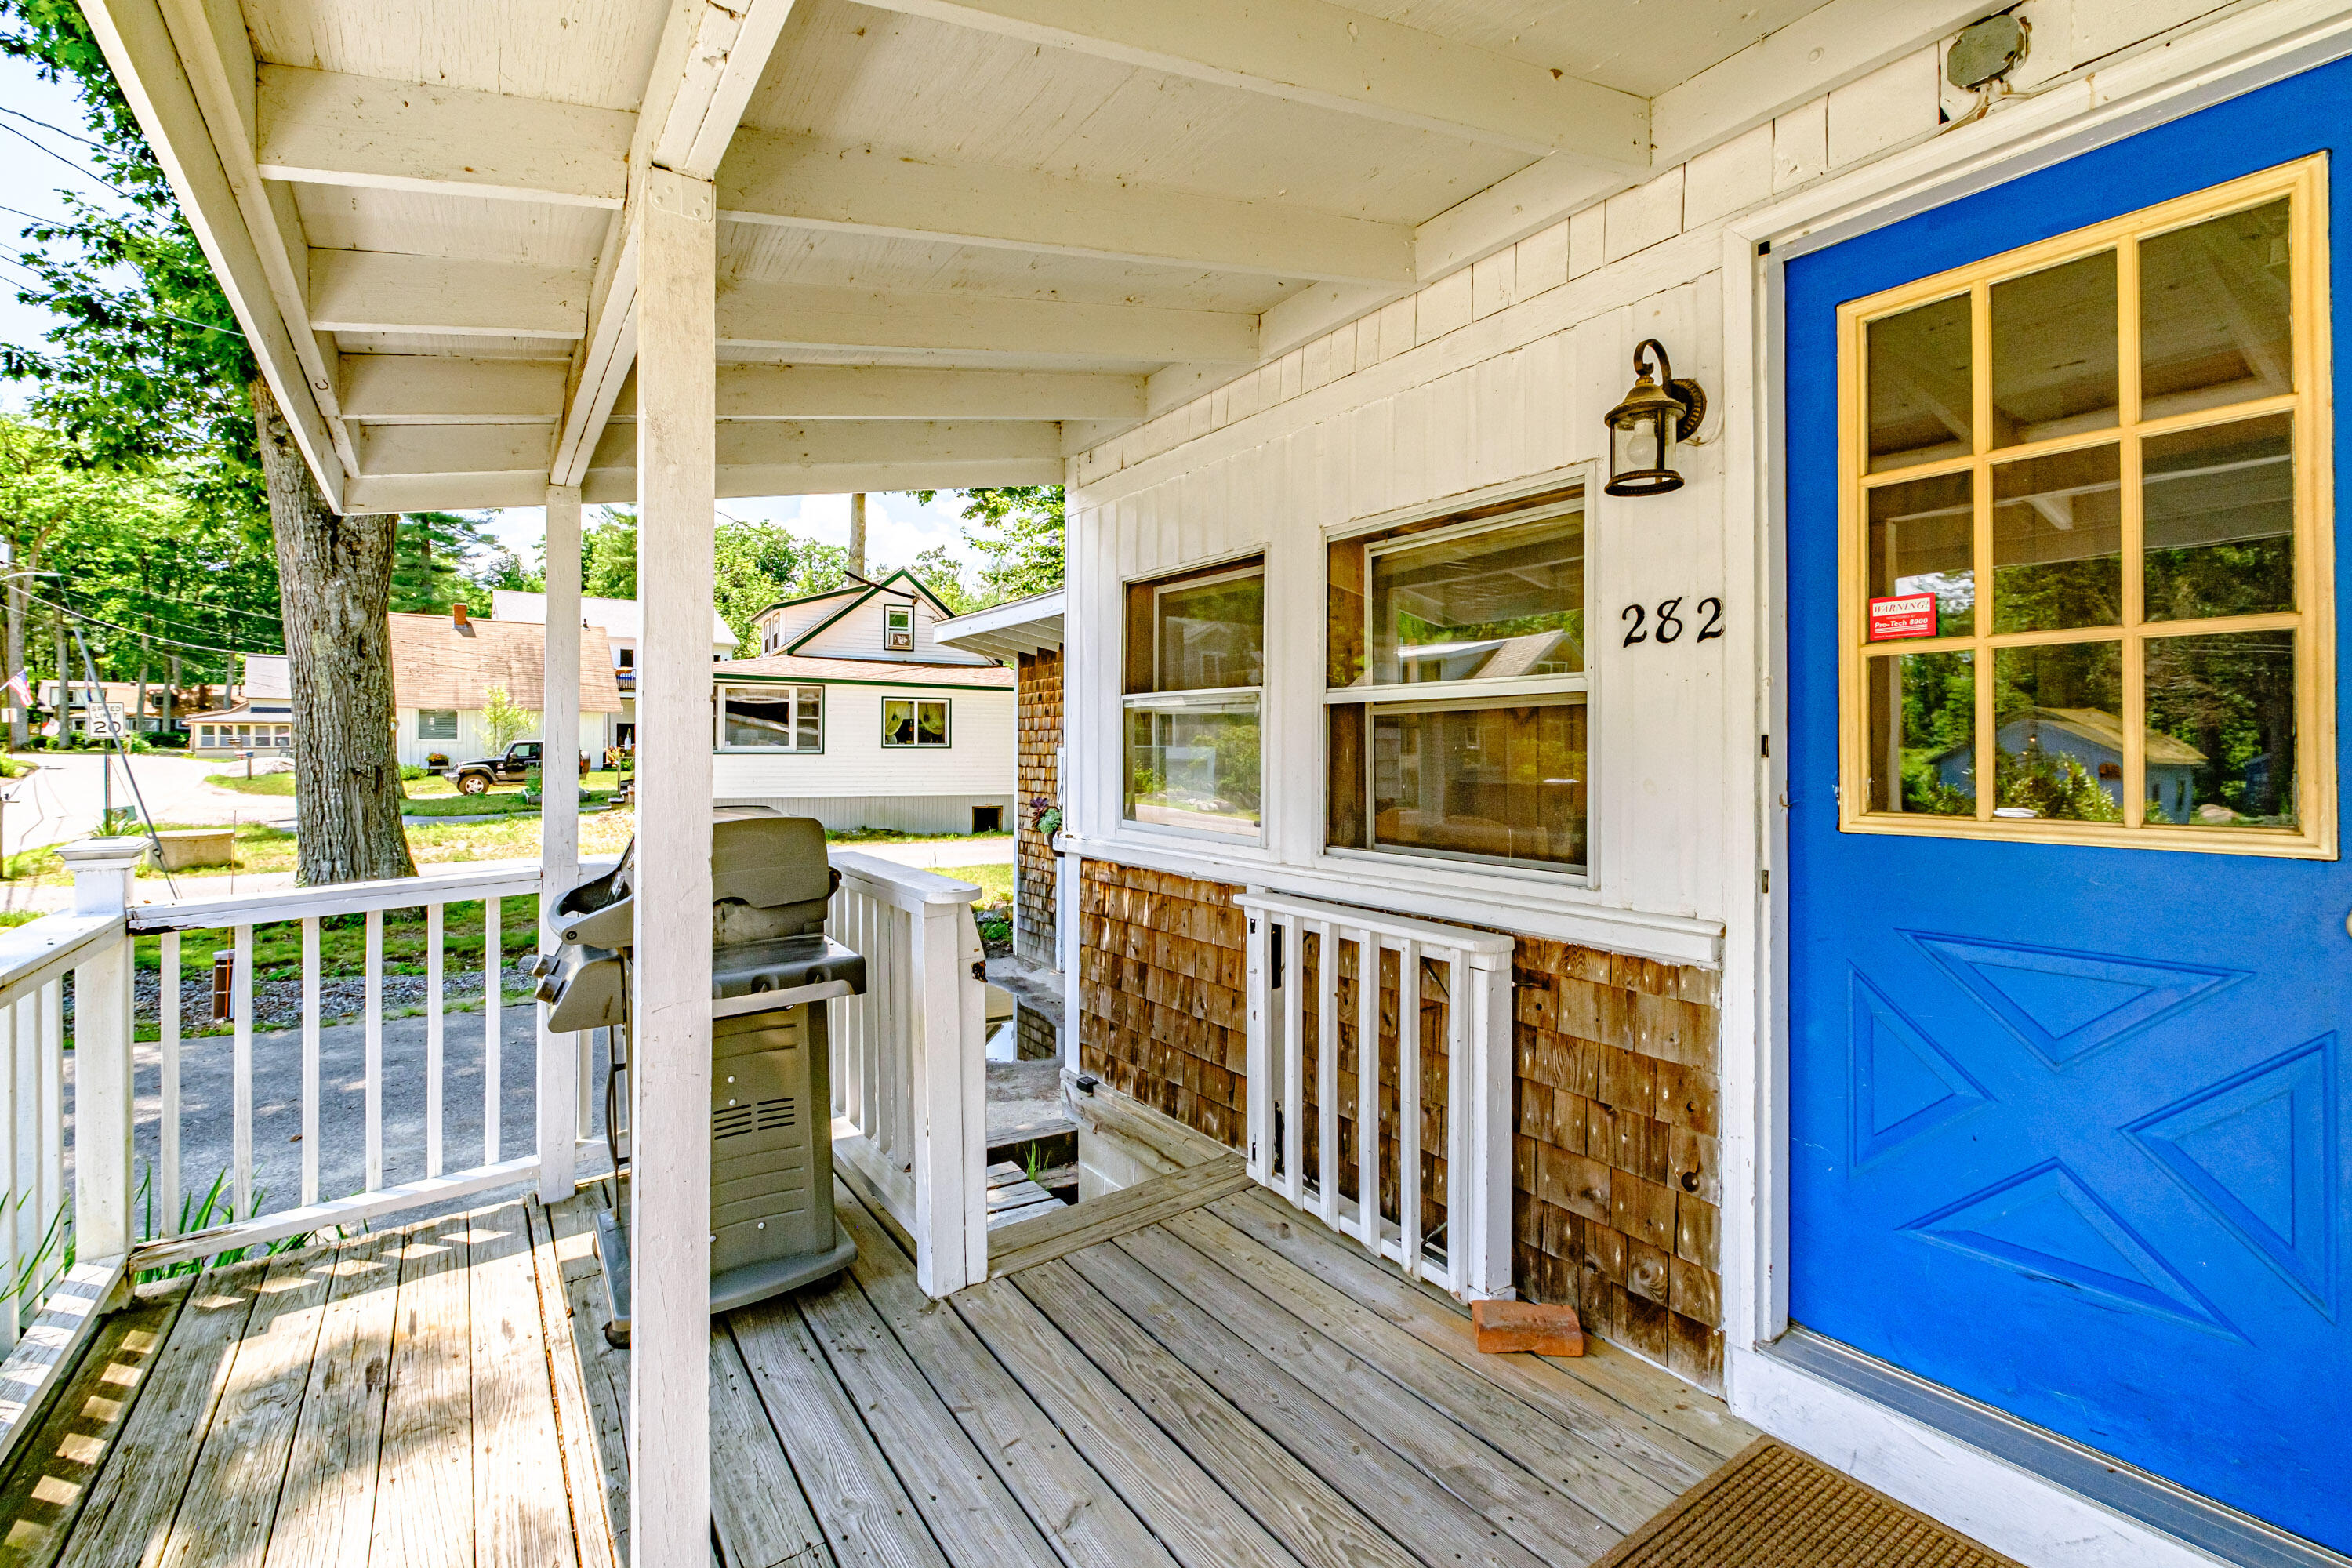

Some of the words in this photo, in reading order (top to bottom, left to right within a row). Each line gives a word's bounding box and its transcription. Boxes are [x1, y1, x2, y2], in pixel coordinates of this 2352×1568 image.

[1874, 600, 1929, 614] WARNING!
[1622, 597, 1725, 648] 282
[1875, 619, 1907, 628] Pro-Tech
[93, 720, 122, 734] 20
